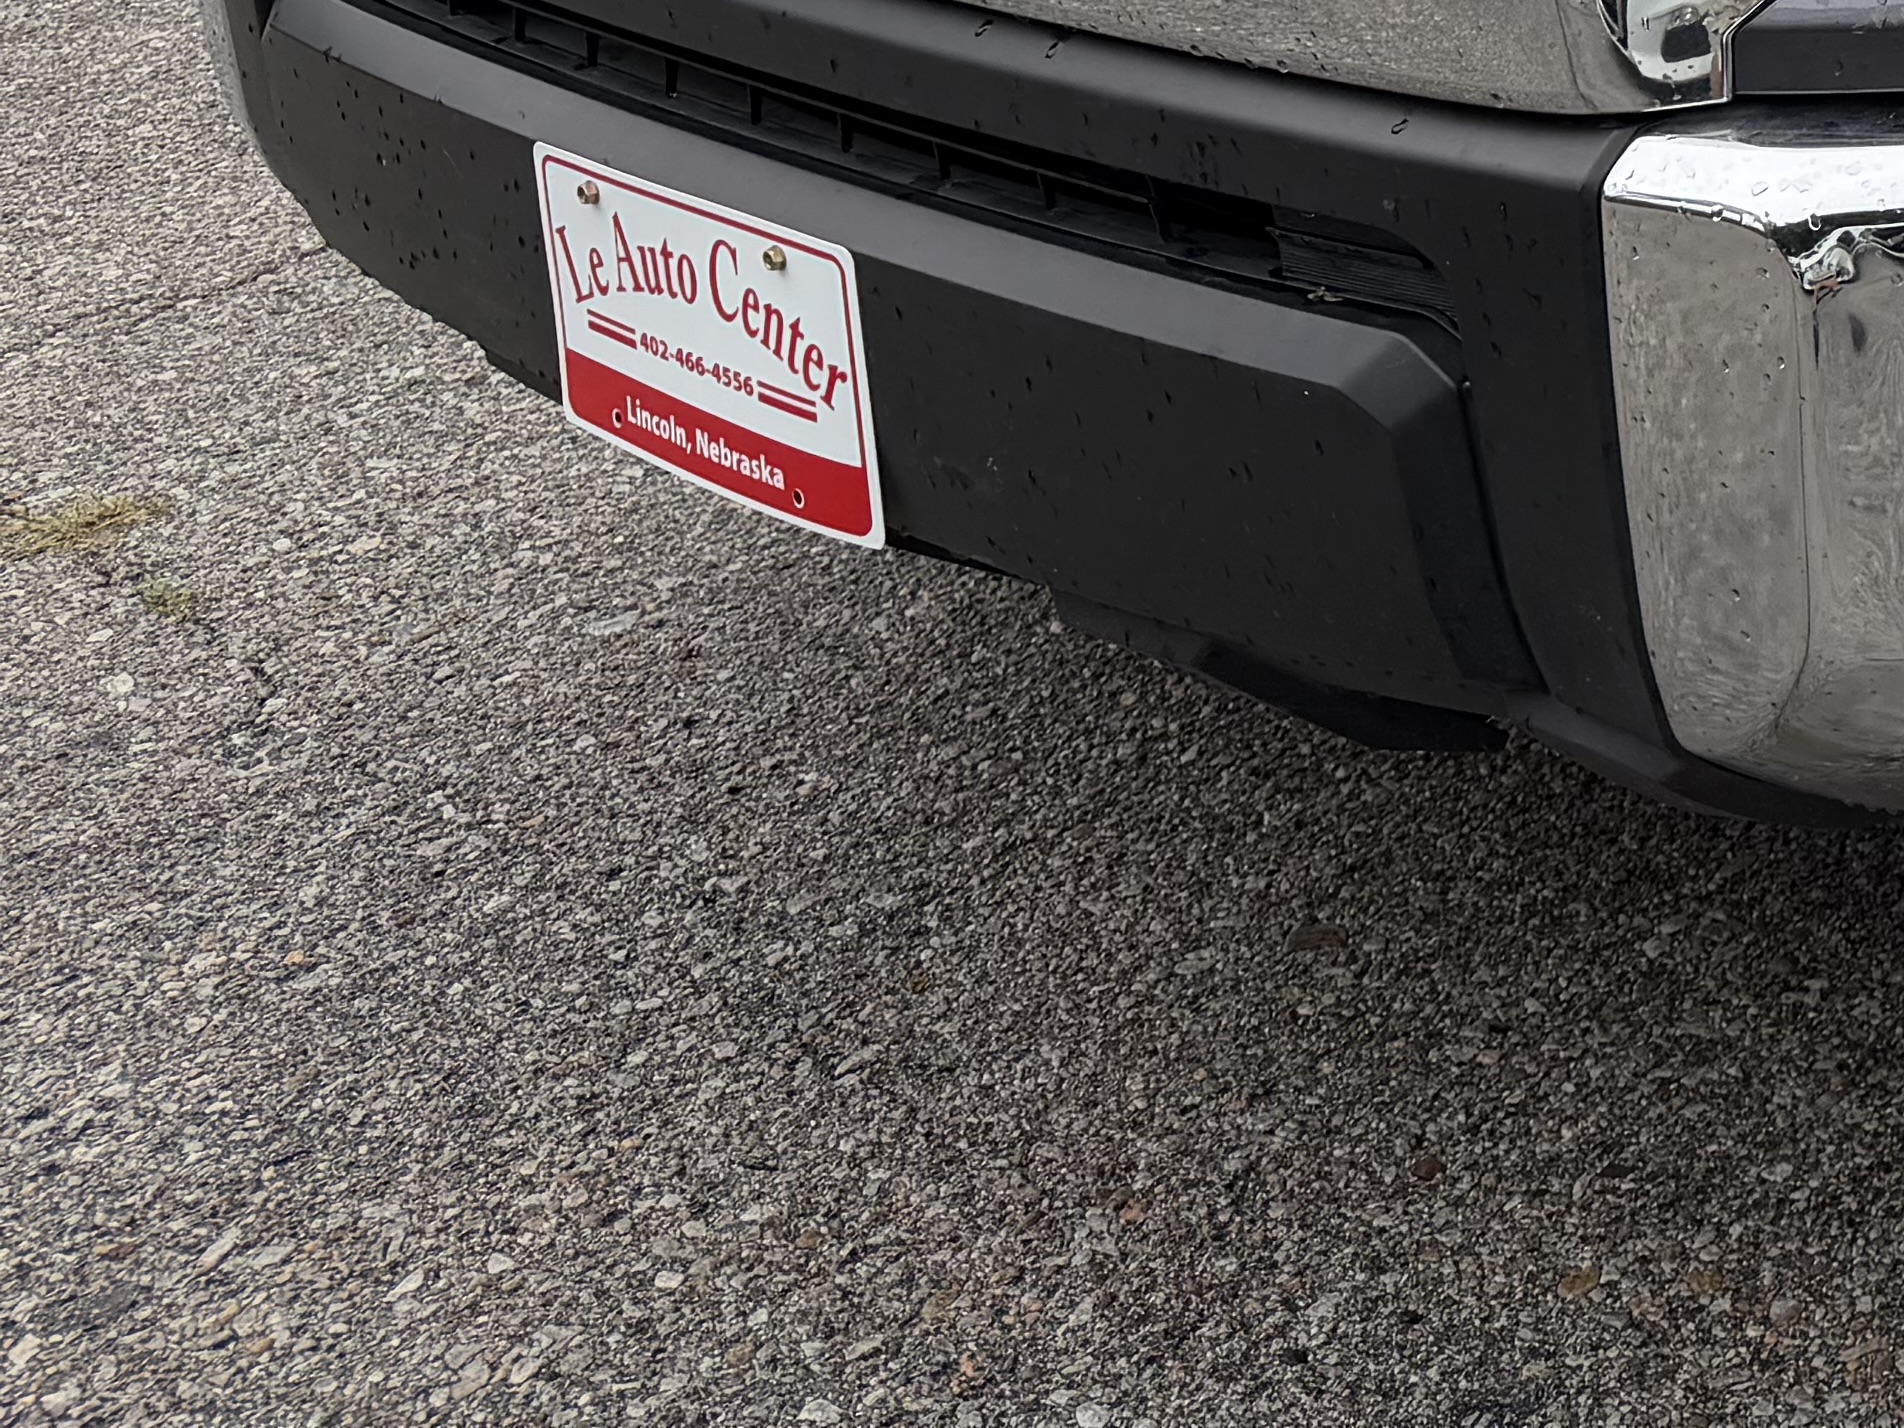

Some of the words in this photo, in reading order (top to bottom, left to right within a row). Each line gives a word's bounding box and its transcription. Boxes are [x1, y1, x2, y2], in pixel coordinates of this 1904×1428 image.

[555, 225, 610, 304] Le
[612, 211, 698, 305] Auto
[708, 239, 848, 411] Center
[639, 332, 755, 397] 402-466-4556
[625, 395, 693, 455] Lincoln,
[695, 428, 785, 491] Nebraska
